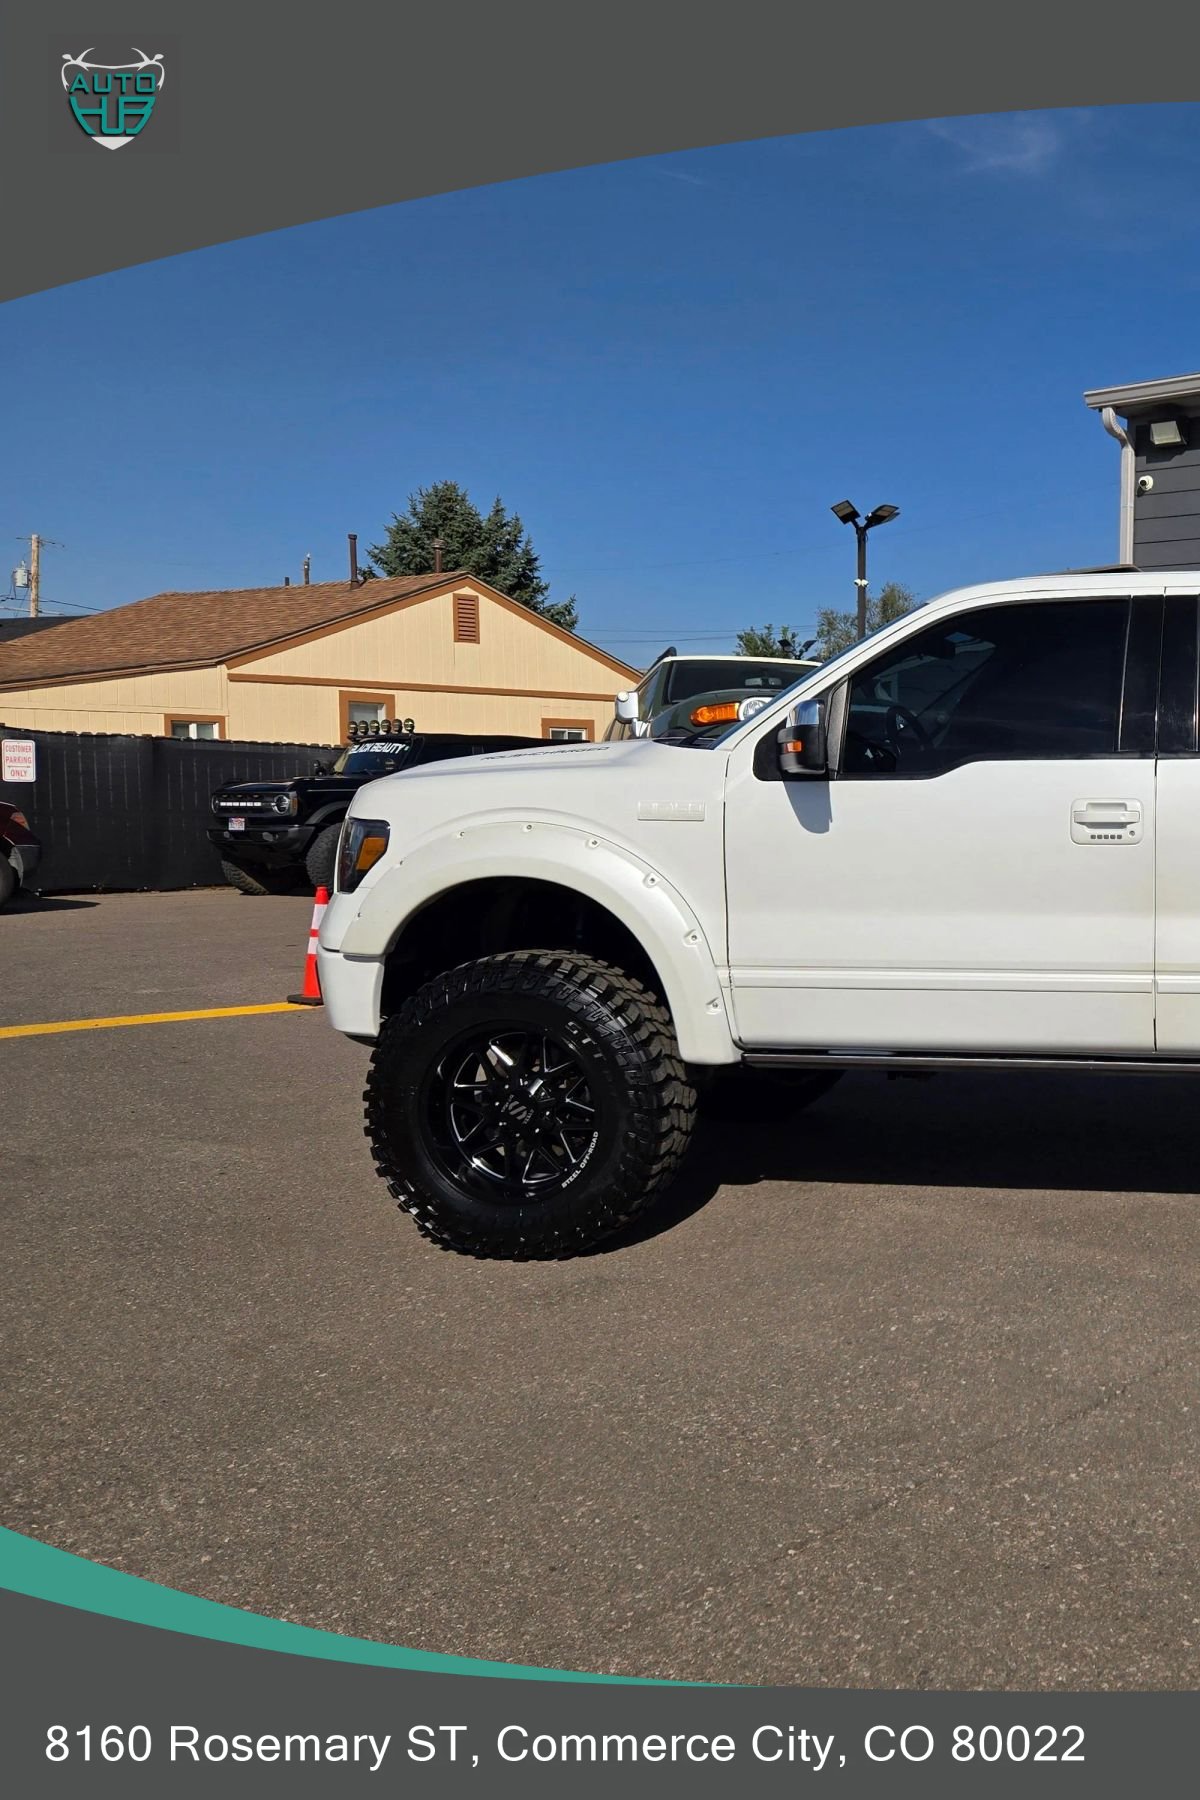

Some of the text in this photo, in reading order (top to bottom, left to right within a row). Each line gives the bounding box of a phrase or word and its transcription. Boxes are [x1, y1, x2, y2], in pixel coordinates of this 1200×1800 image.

[5, 744, 32, 753] CUSTOMER
[369, 742, 405, 754] BEAUTY
[5, 756, 32, 764] PARKING
[10, 769, 27, 777] ONLY
[561, 1169, 581, 1189] STEEL
